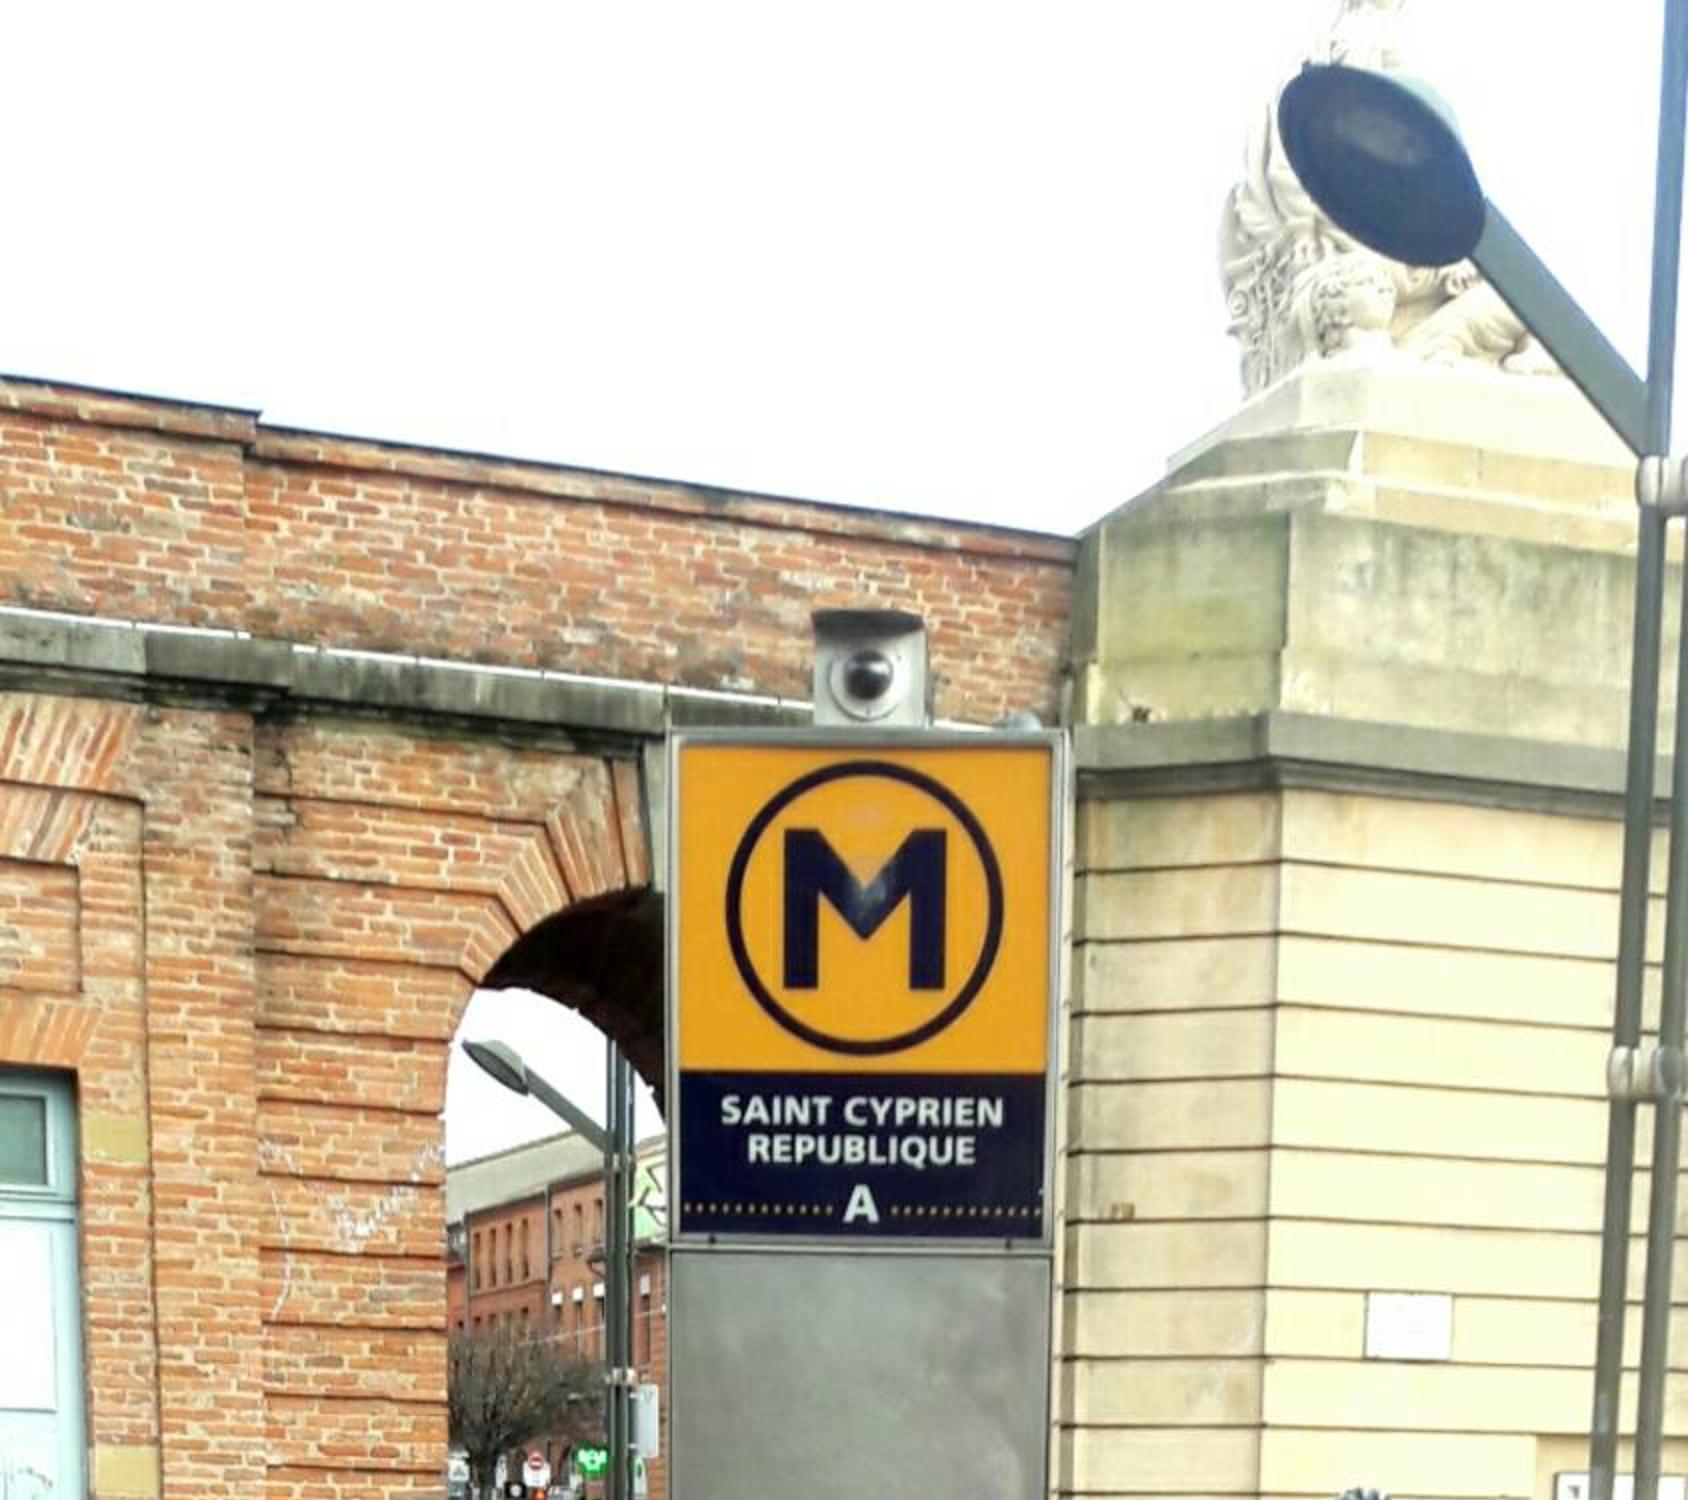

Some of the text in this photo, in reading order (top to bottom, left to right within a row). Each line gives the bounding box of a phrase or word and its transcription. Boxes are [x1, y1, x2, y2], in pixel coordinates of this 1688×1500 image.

[784, 828, 947, 990] M
[721, 1096, 1004, 1128] SAINT CYPRIEN
[747, 1134, 976, 1169] REPUBLIQUE
[843, 1184, 880, 1223] A
